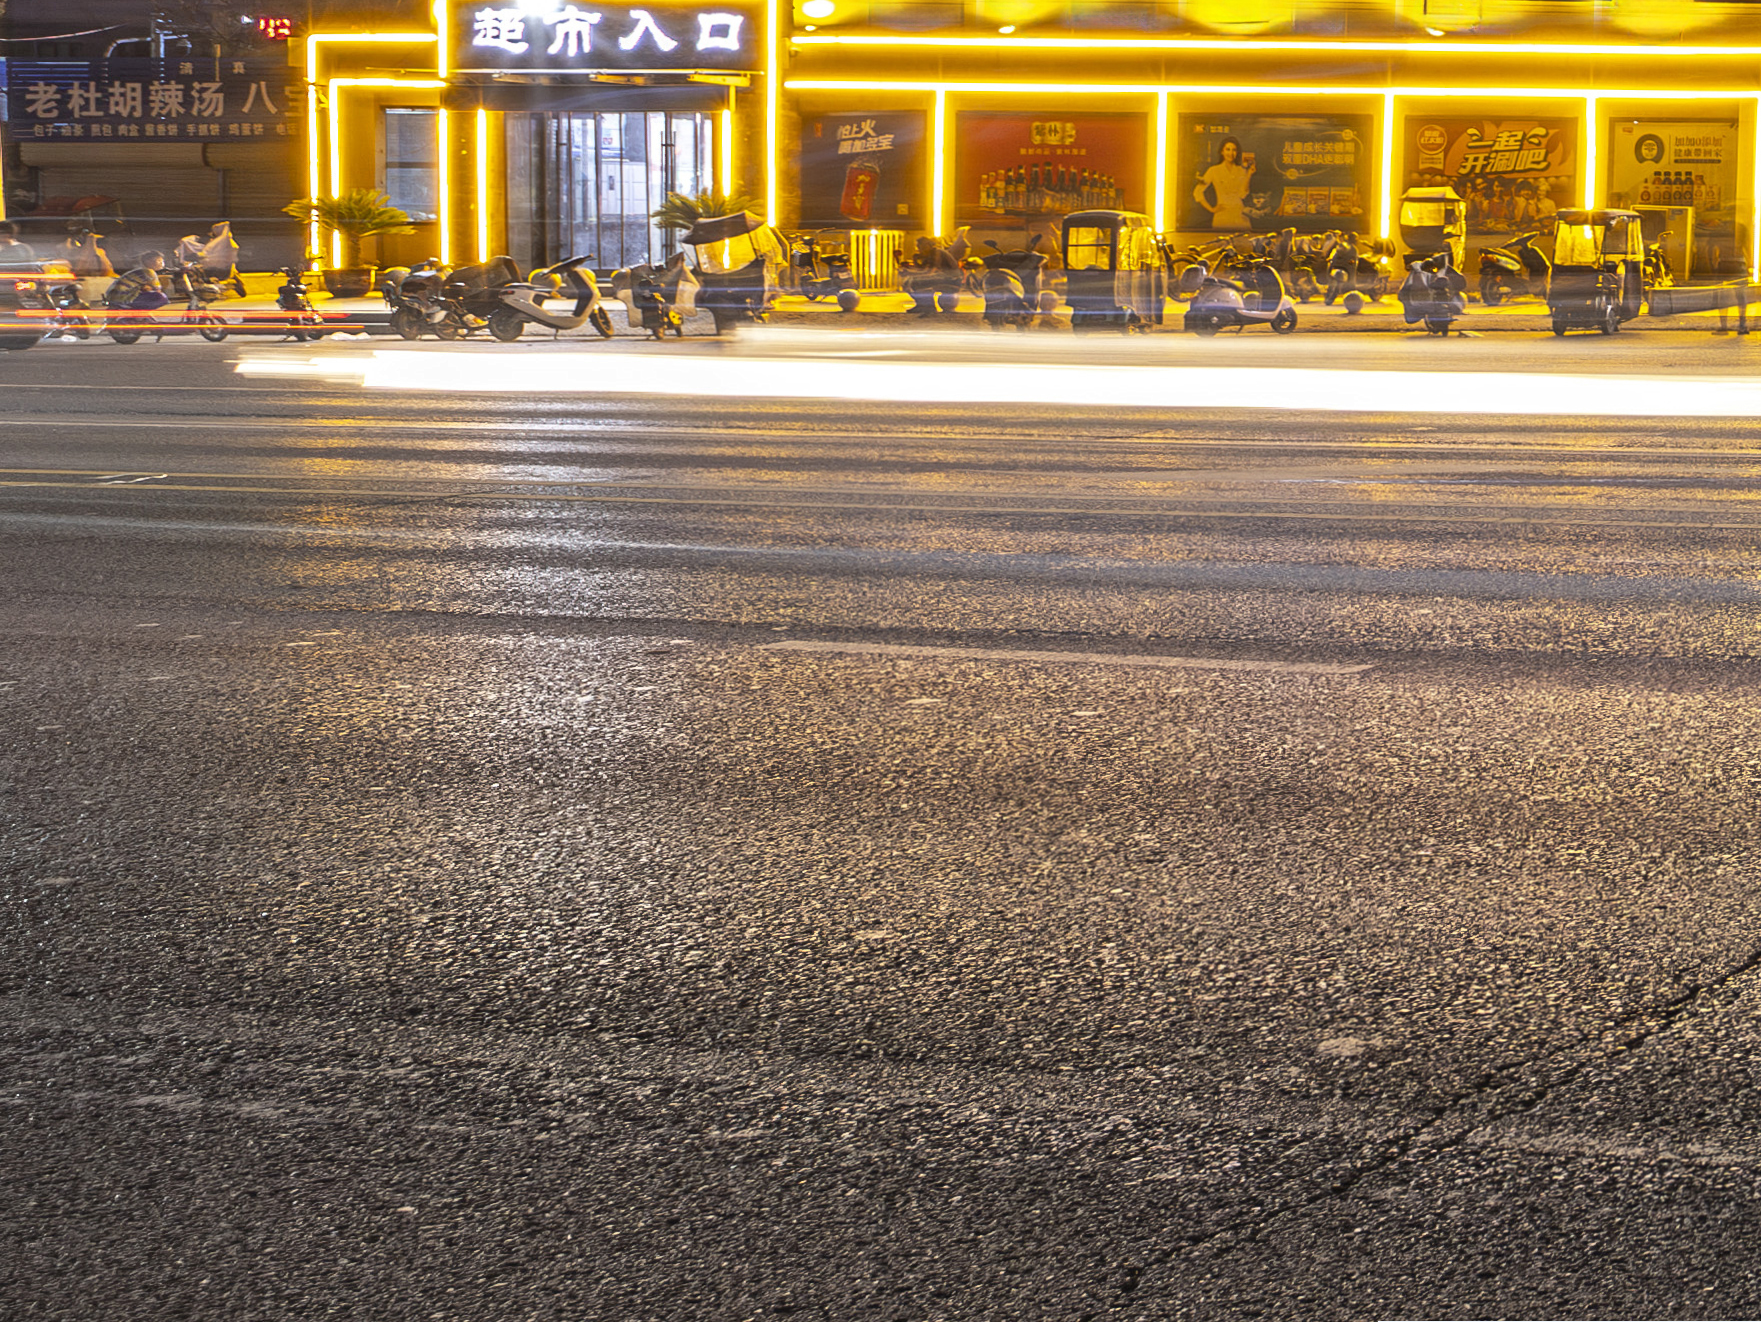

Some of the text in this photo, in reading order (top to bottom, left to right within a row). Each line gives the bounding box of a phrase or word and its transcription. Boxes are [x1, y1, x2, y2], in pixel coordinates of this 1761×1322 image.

[472, 4, 745, 57] 超市入口
[25, 81, 224, 119] 老杜胡辣汤
[1467, 130, 1525, 152] 一起
[1457, 147, 1551, 175] 开涮吧
